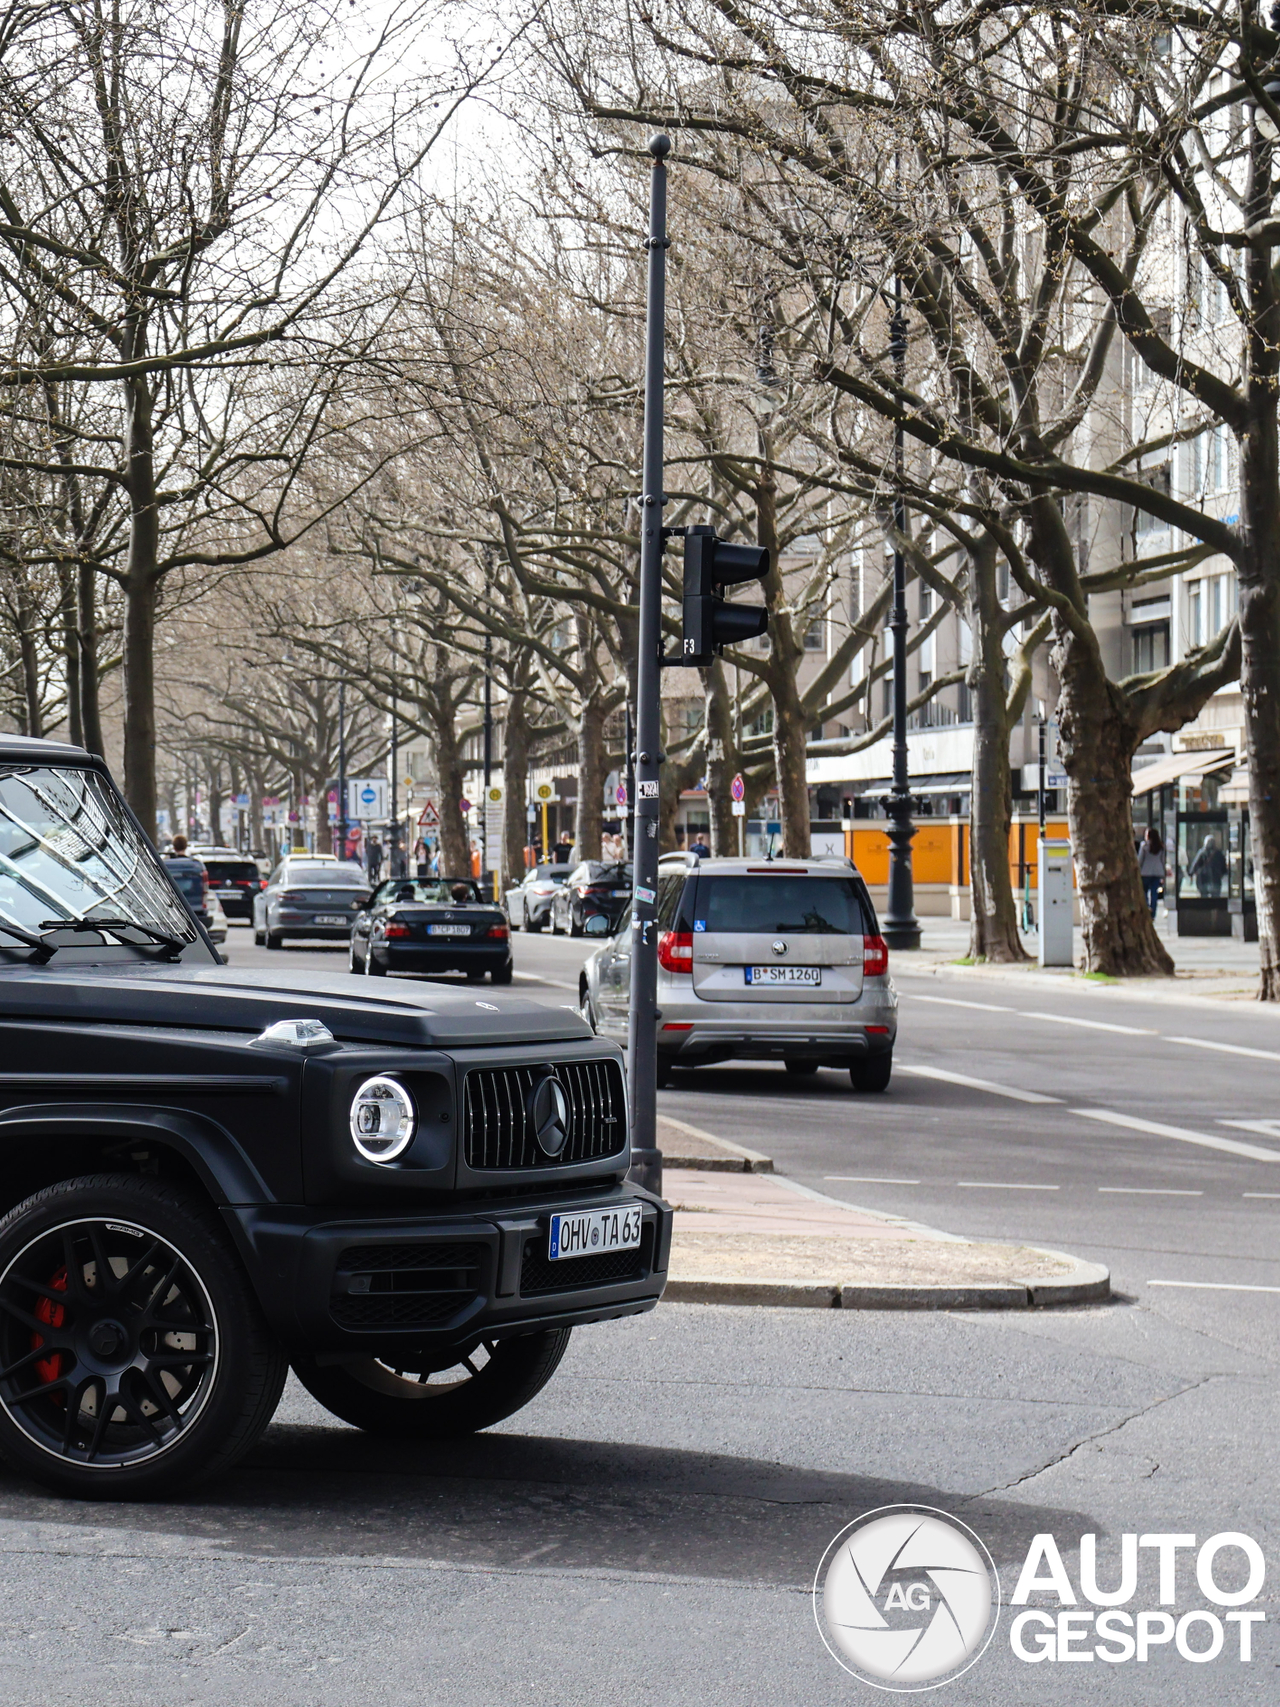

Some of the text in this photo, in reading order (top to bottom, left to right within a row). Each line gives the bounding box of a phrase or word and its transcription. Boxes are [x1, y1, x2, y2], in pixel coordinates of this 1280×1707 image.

[683, 638, 695, 654] F3
[753, 967, 819, 980] B SM 1260
[560, 1210, 641, 1252] OHV TA 63
